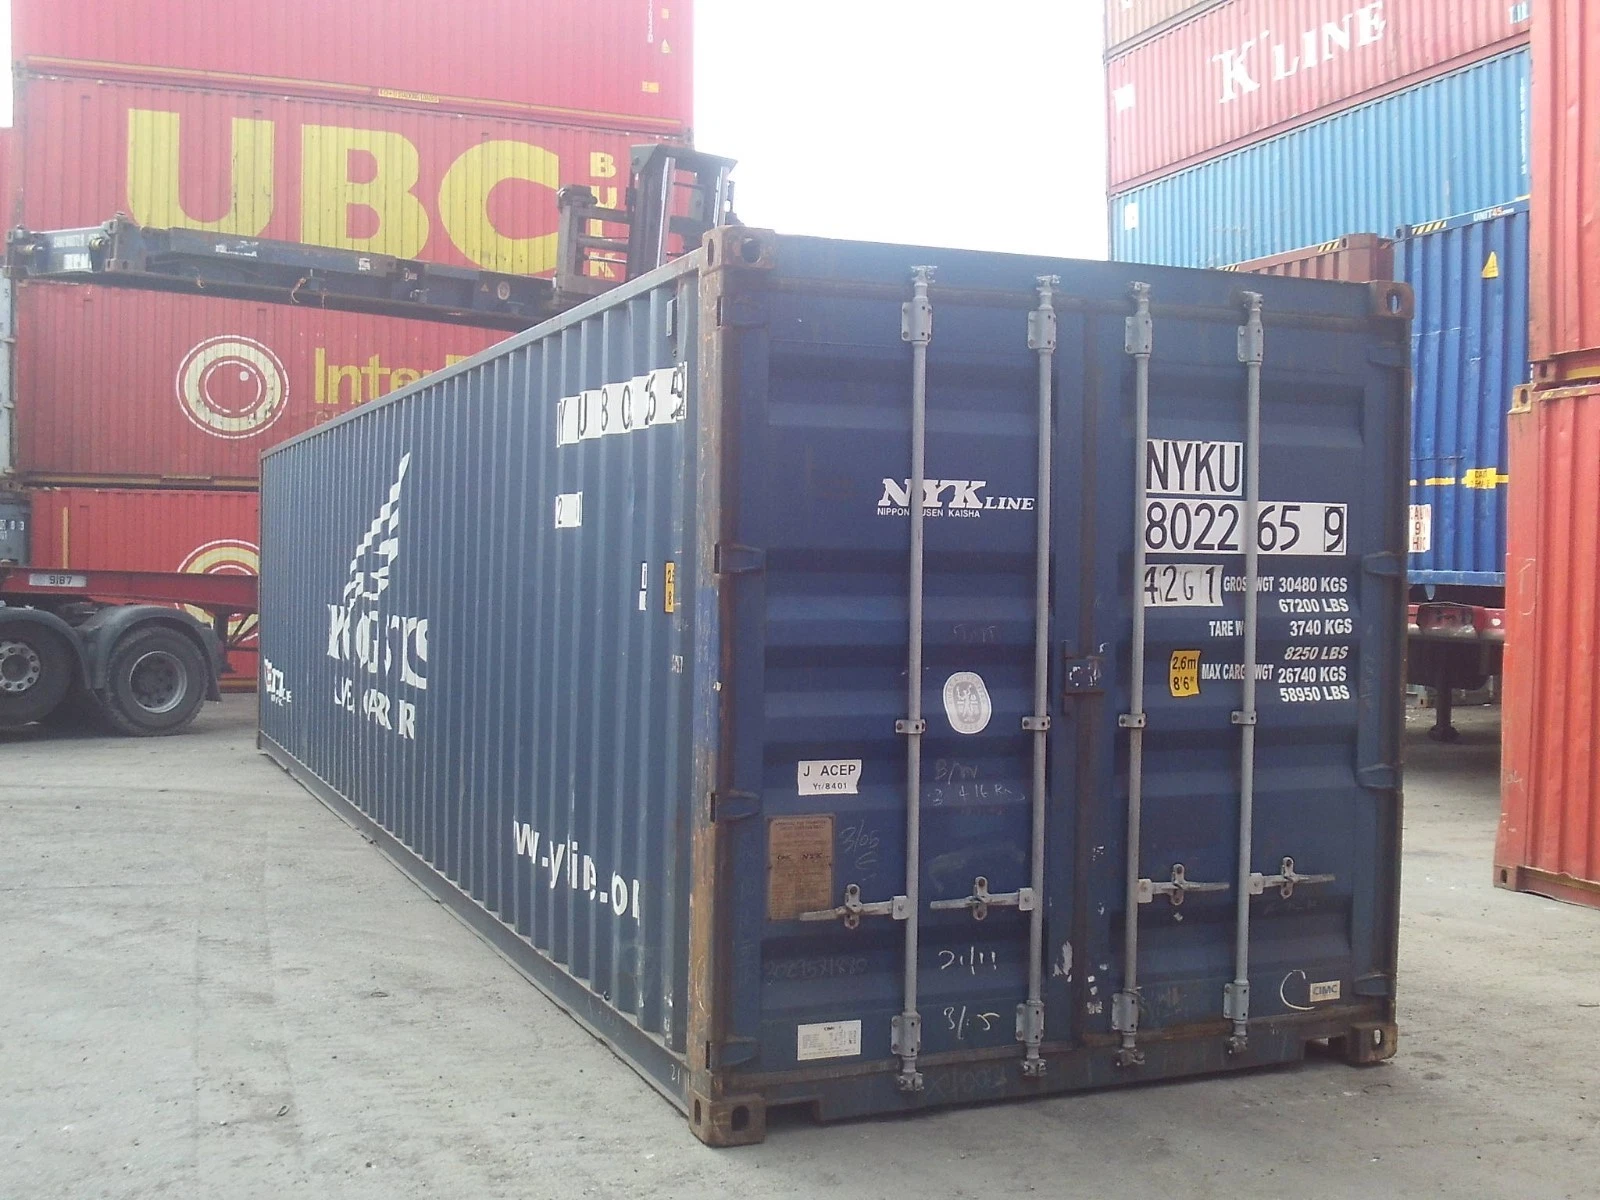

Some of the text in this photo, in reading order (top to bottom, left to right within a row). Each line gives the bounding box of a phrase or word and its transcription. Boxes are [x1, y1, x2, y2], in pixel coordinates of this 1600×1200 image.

[1272, 0, 1387, 81] LINE
[127, 107, 559, 277] UBC
[315, 347, 433, 404] Inte
[1146, 441, 1240, 492] NYKU
[877, 478, 1035, 511] NYK LINE
[877, 507, 981, 518] NIPPON USEN KAISHA
[1223, 576, 1247, 592] GROS
[1279, 577, 1318, 592] 30480
[1320, 577, 1348, 592] KGS
[1279, 598, 1349, 613] 67200 LBS
[1209, 620, 1234, 636] TARE
[1290, 618, 1353, 636] 3740 KGS
[1284, 645, 1349, 660] 8250 LBS
[1201, 664, 1222, 679] MAX
[1223, 664, 1245, 680] CARG
[1278, 666, 1317, 683] 26740
[1320, 666, 1347, 682] KGS
[1280, 685, 1350, 702] 58950 LBS
[820, 764, 856, 776] ACEP
